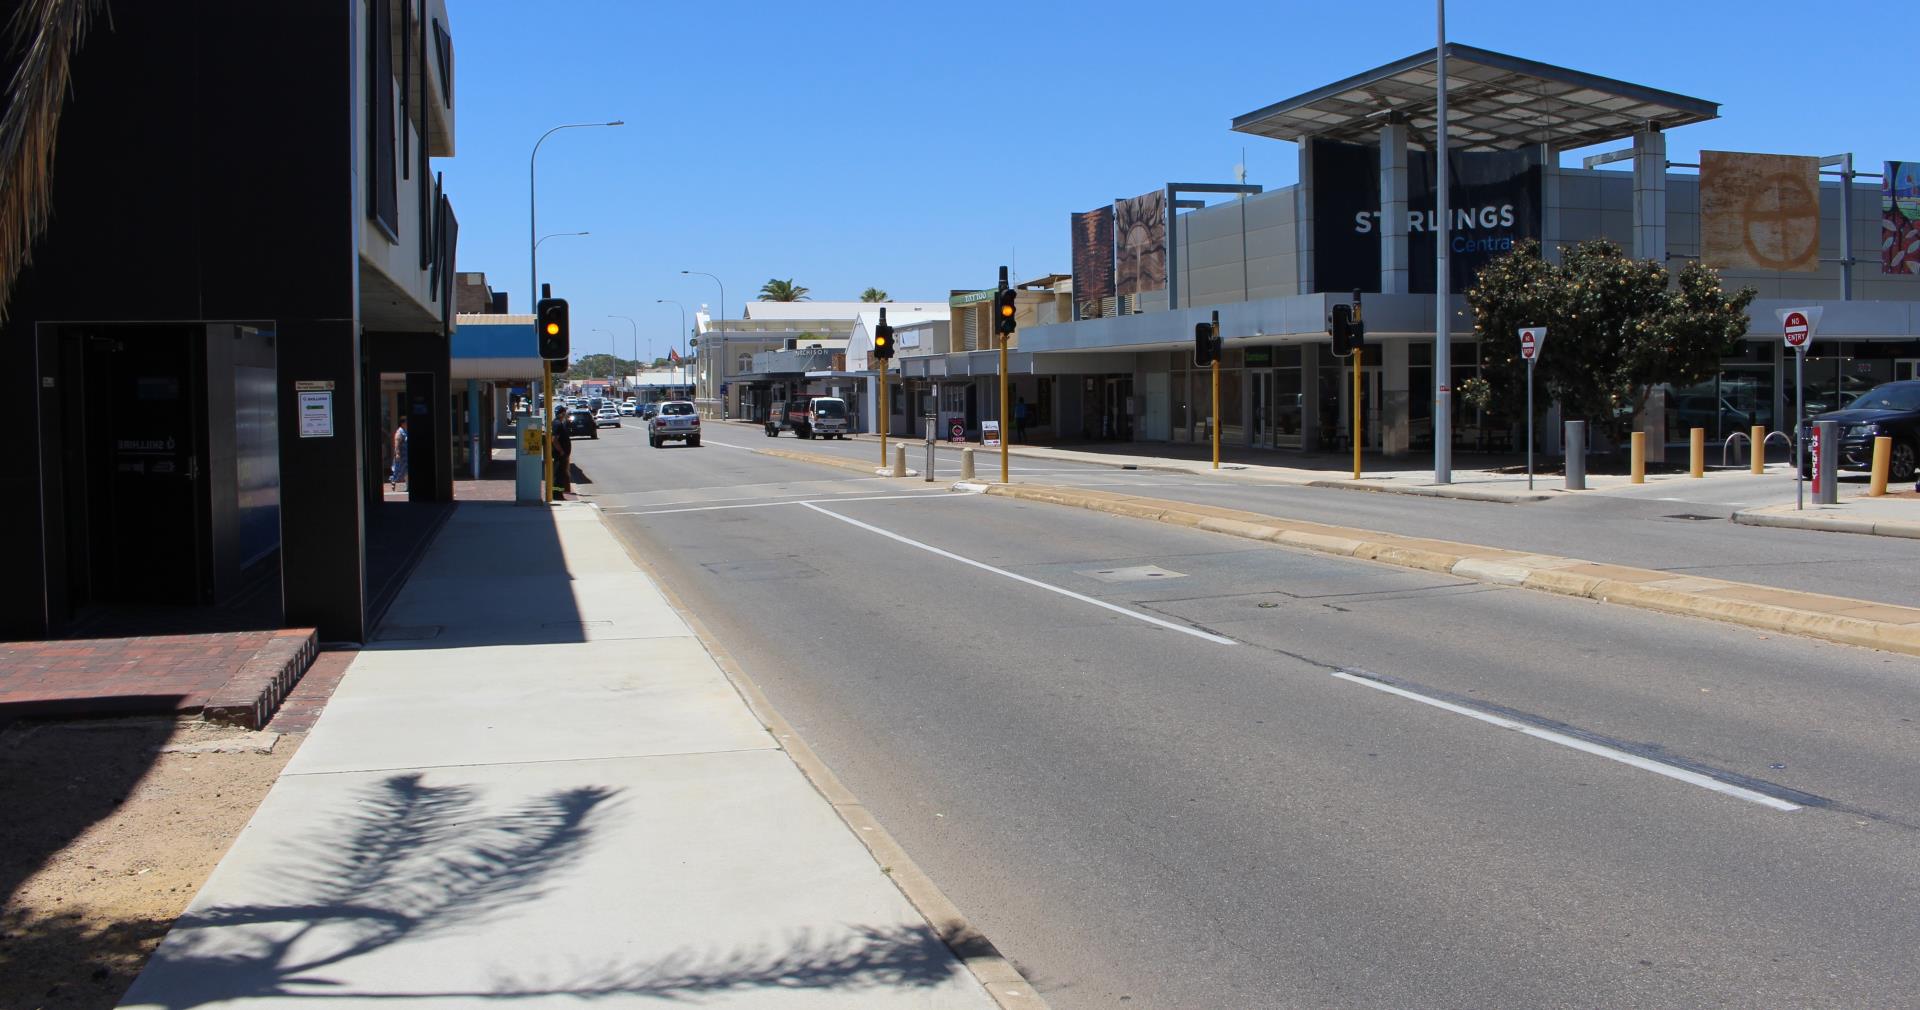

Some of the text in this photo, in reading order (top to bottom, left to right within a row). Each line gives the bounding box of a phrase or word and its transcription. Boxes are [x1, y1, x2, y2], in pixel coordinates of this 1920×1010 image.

[1355, 204, 1514, 233] STRLINGS
[1791, 317, 1800, 325] NO
[1787, 333, 1805, 342] ENTRY
[1812, 434, 1819, 447] NO
